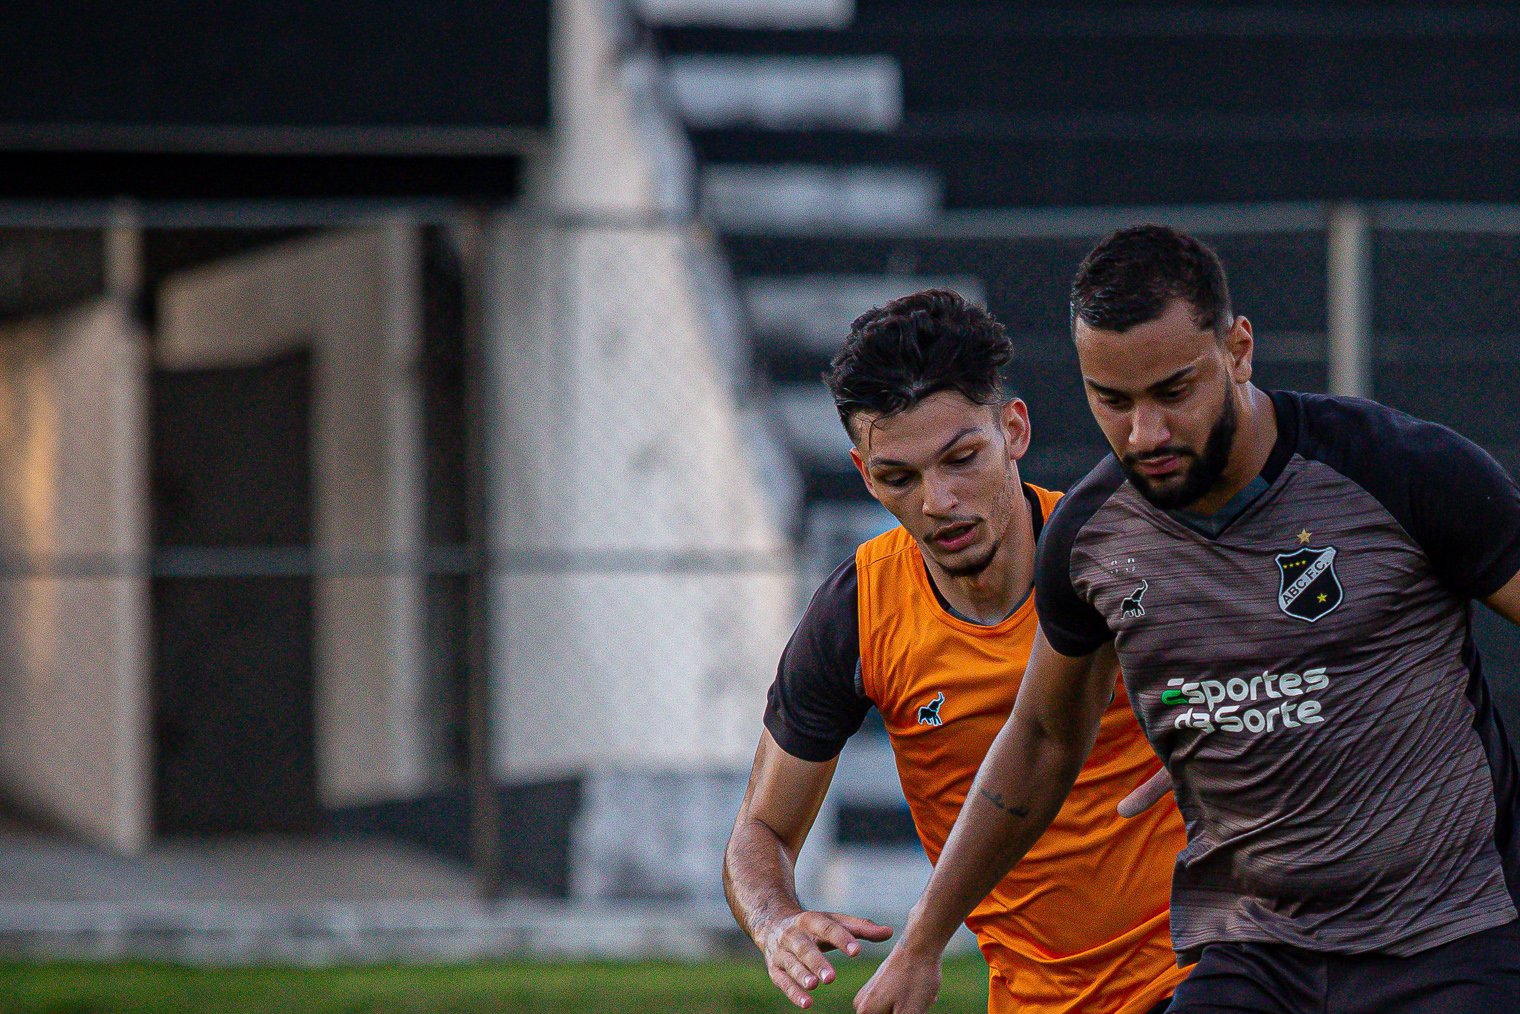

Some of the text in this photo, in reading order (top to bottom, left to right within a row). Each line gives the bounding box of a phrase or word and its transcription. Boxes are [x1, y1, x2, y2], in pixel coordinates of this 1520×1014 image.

[1282, 560, 1330, 605] ABC F.C.
[1161, 666, 1330, 712] Esportes
[1214, 700, 1325, 734] Sorte
